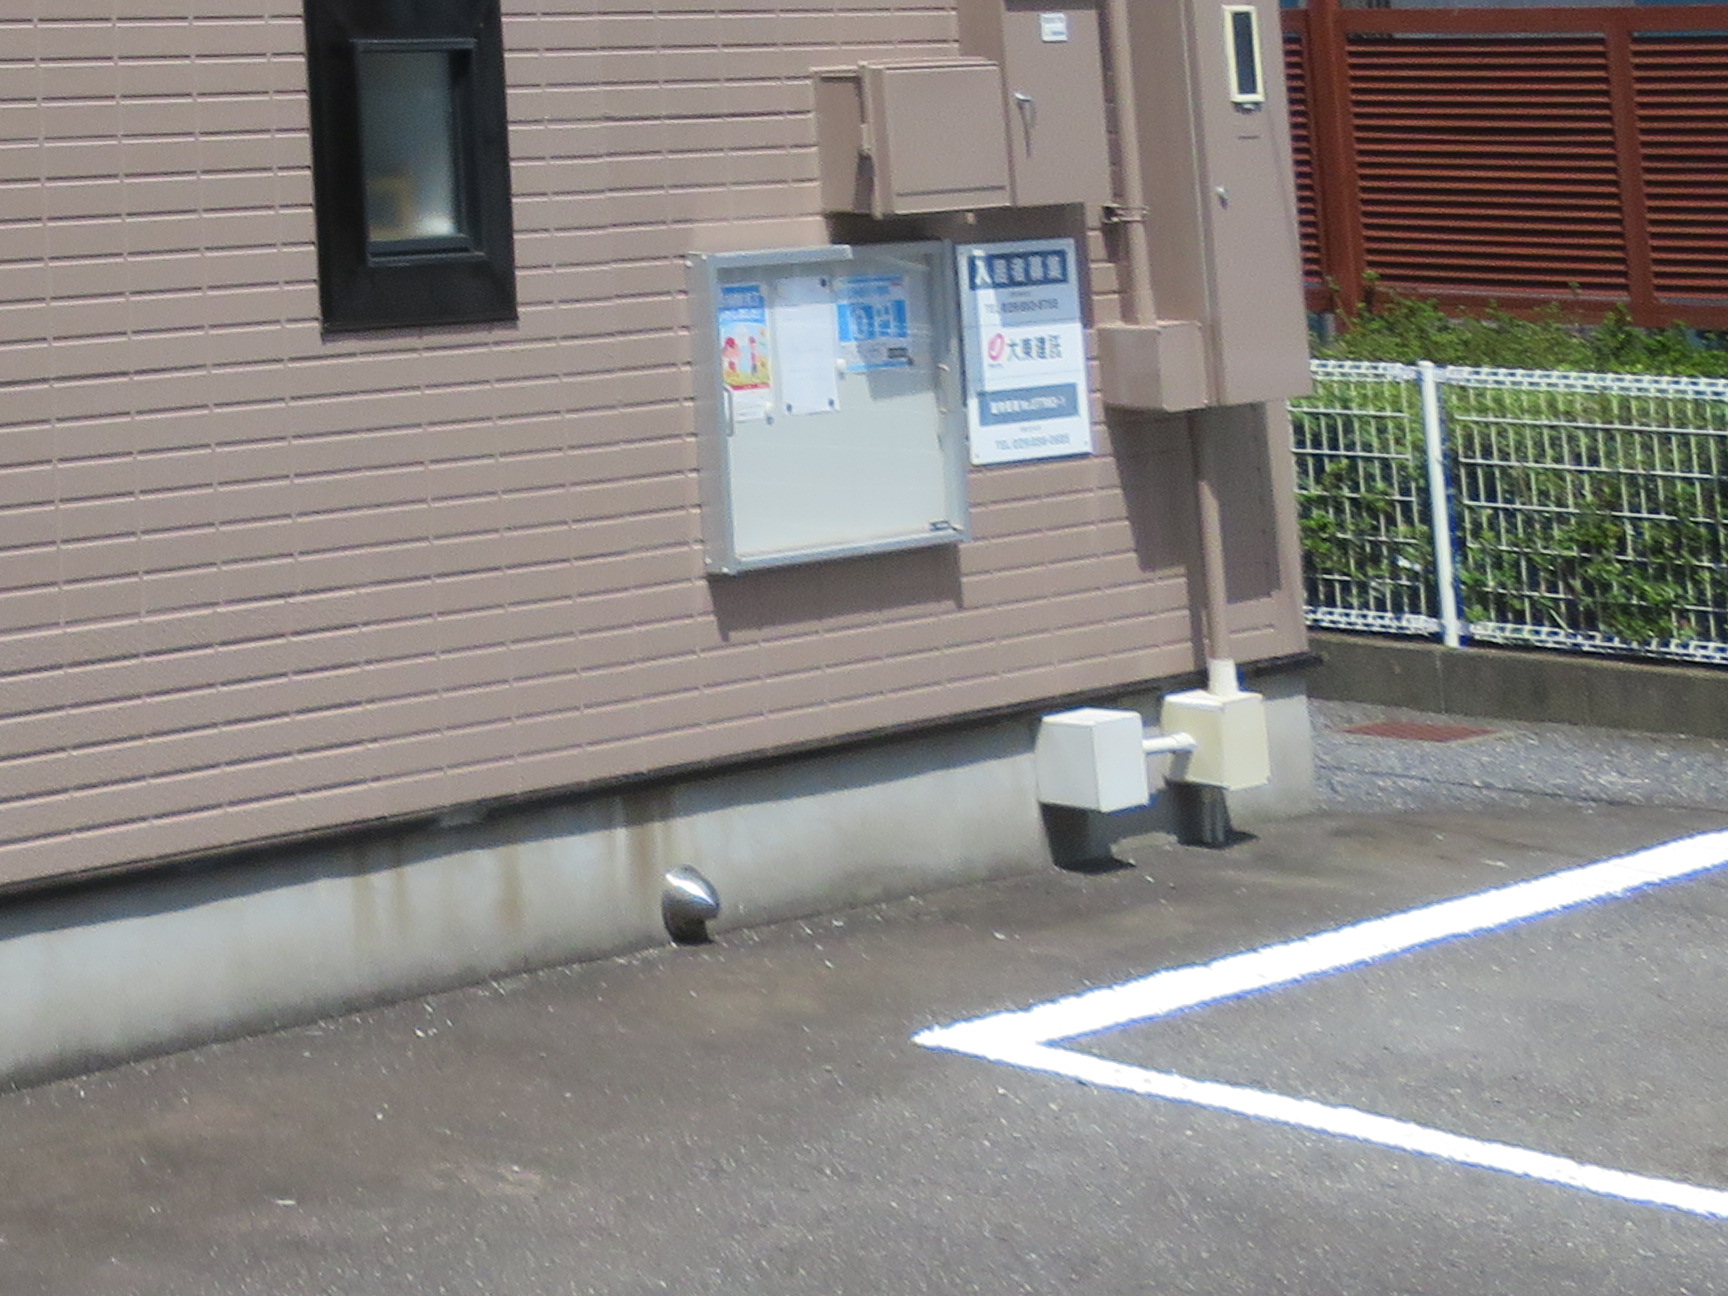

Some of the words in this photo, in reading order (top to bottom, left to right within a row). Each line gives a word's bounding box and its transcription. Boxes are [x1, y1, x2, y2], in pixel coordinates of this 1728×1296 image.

[973, 253, 1063, 286] 入居者募集
[1006, 334, 1063, 362] 大東建託
